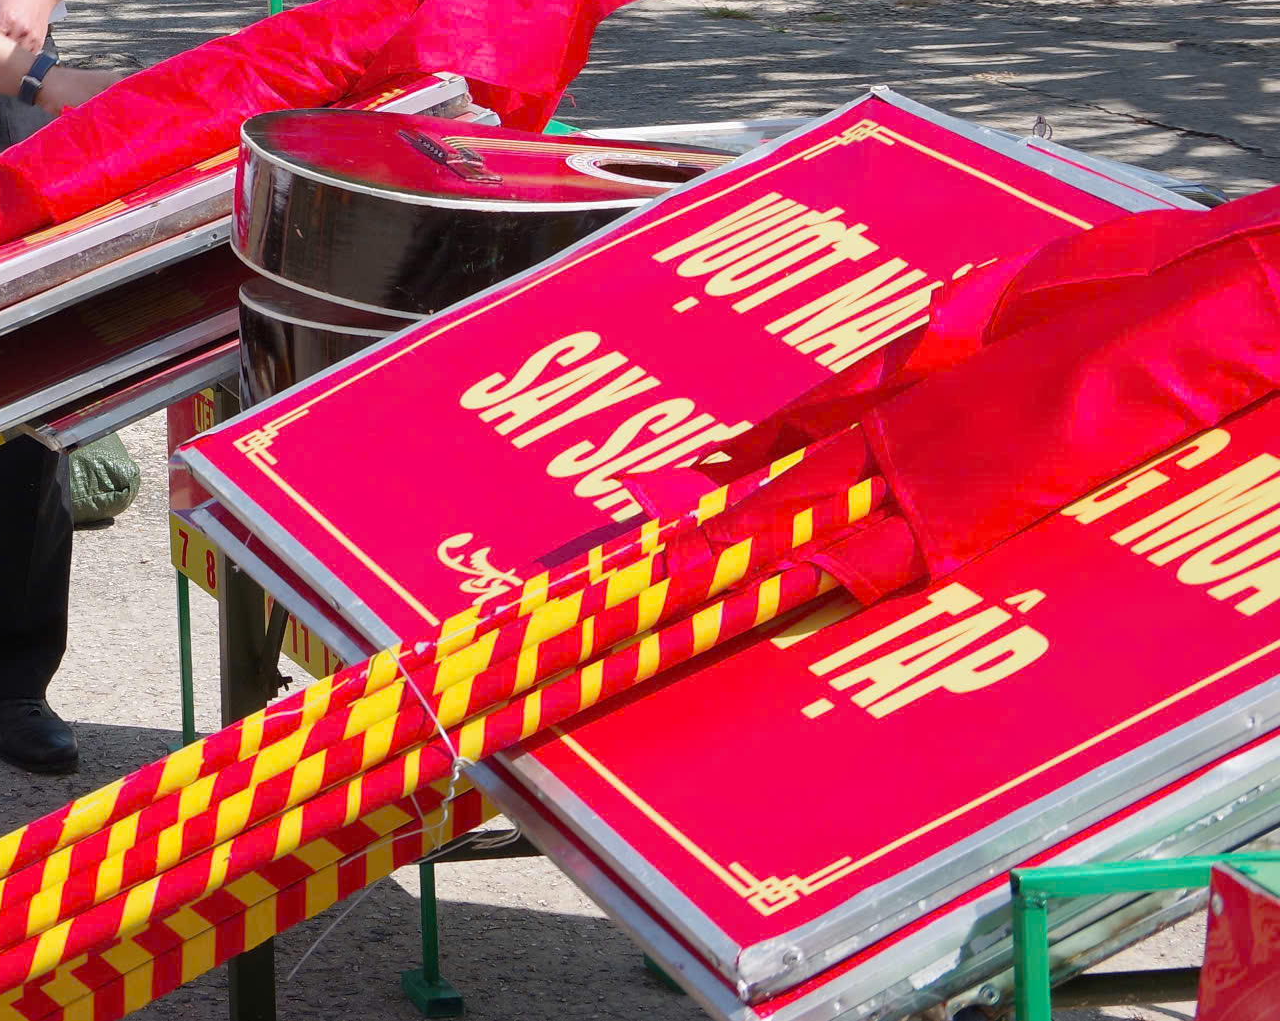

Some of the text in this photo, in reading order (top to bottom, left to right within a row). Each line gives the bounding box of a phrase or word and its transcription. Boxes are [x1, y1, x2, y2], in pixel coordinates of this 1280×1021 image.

[651, 191, 880, 314] VƯỢT
[459, 331, 662, 449] SAY
[178, 528, 217, 590] 7 8
[800, 581, 1050, 720] TẬP
